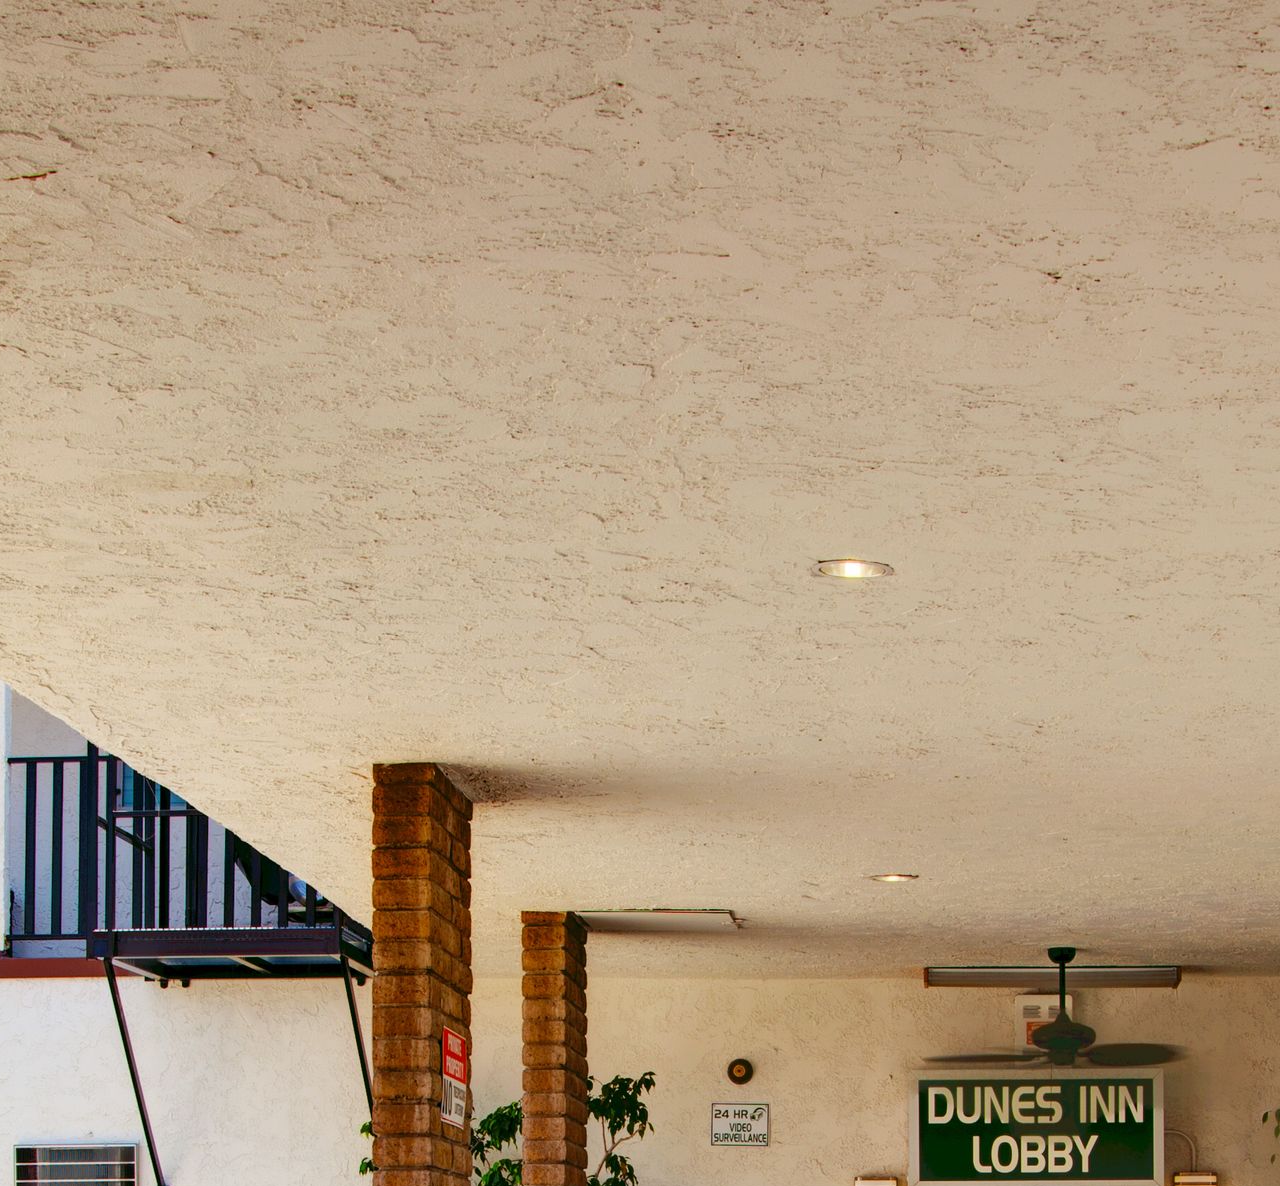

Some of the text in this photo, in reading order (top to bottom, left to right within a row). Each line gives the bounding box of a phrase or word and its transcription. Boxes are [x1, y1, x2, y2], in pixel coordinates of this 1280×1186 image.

[441, 1078, 453, 1116] NO
[927, 1085, 1144, 1124] DUNES INN
[714, 1109, 749, 1119] 24 HR
[713, 1133, 767, 1143] SURVEILLANCE
[729, 1122, 752, 1132] VIDEO
[972, 1135, 1099, 1173] LOBBY
